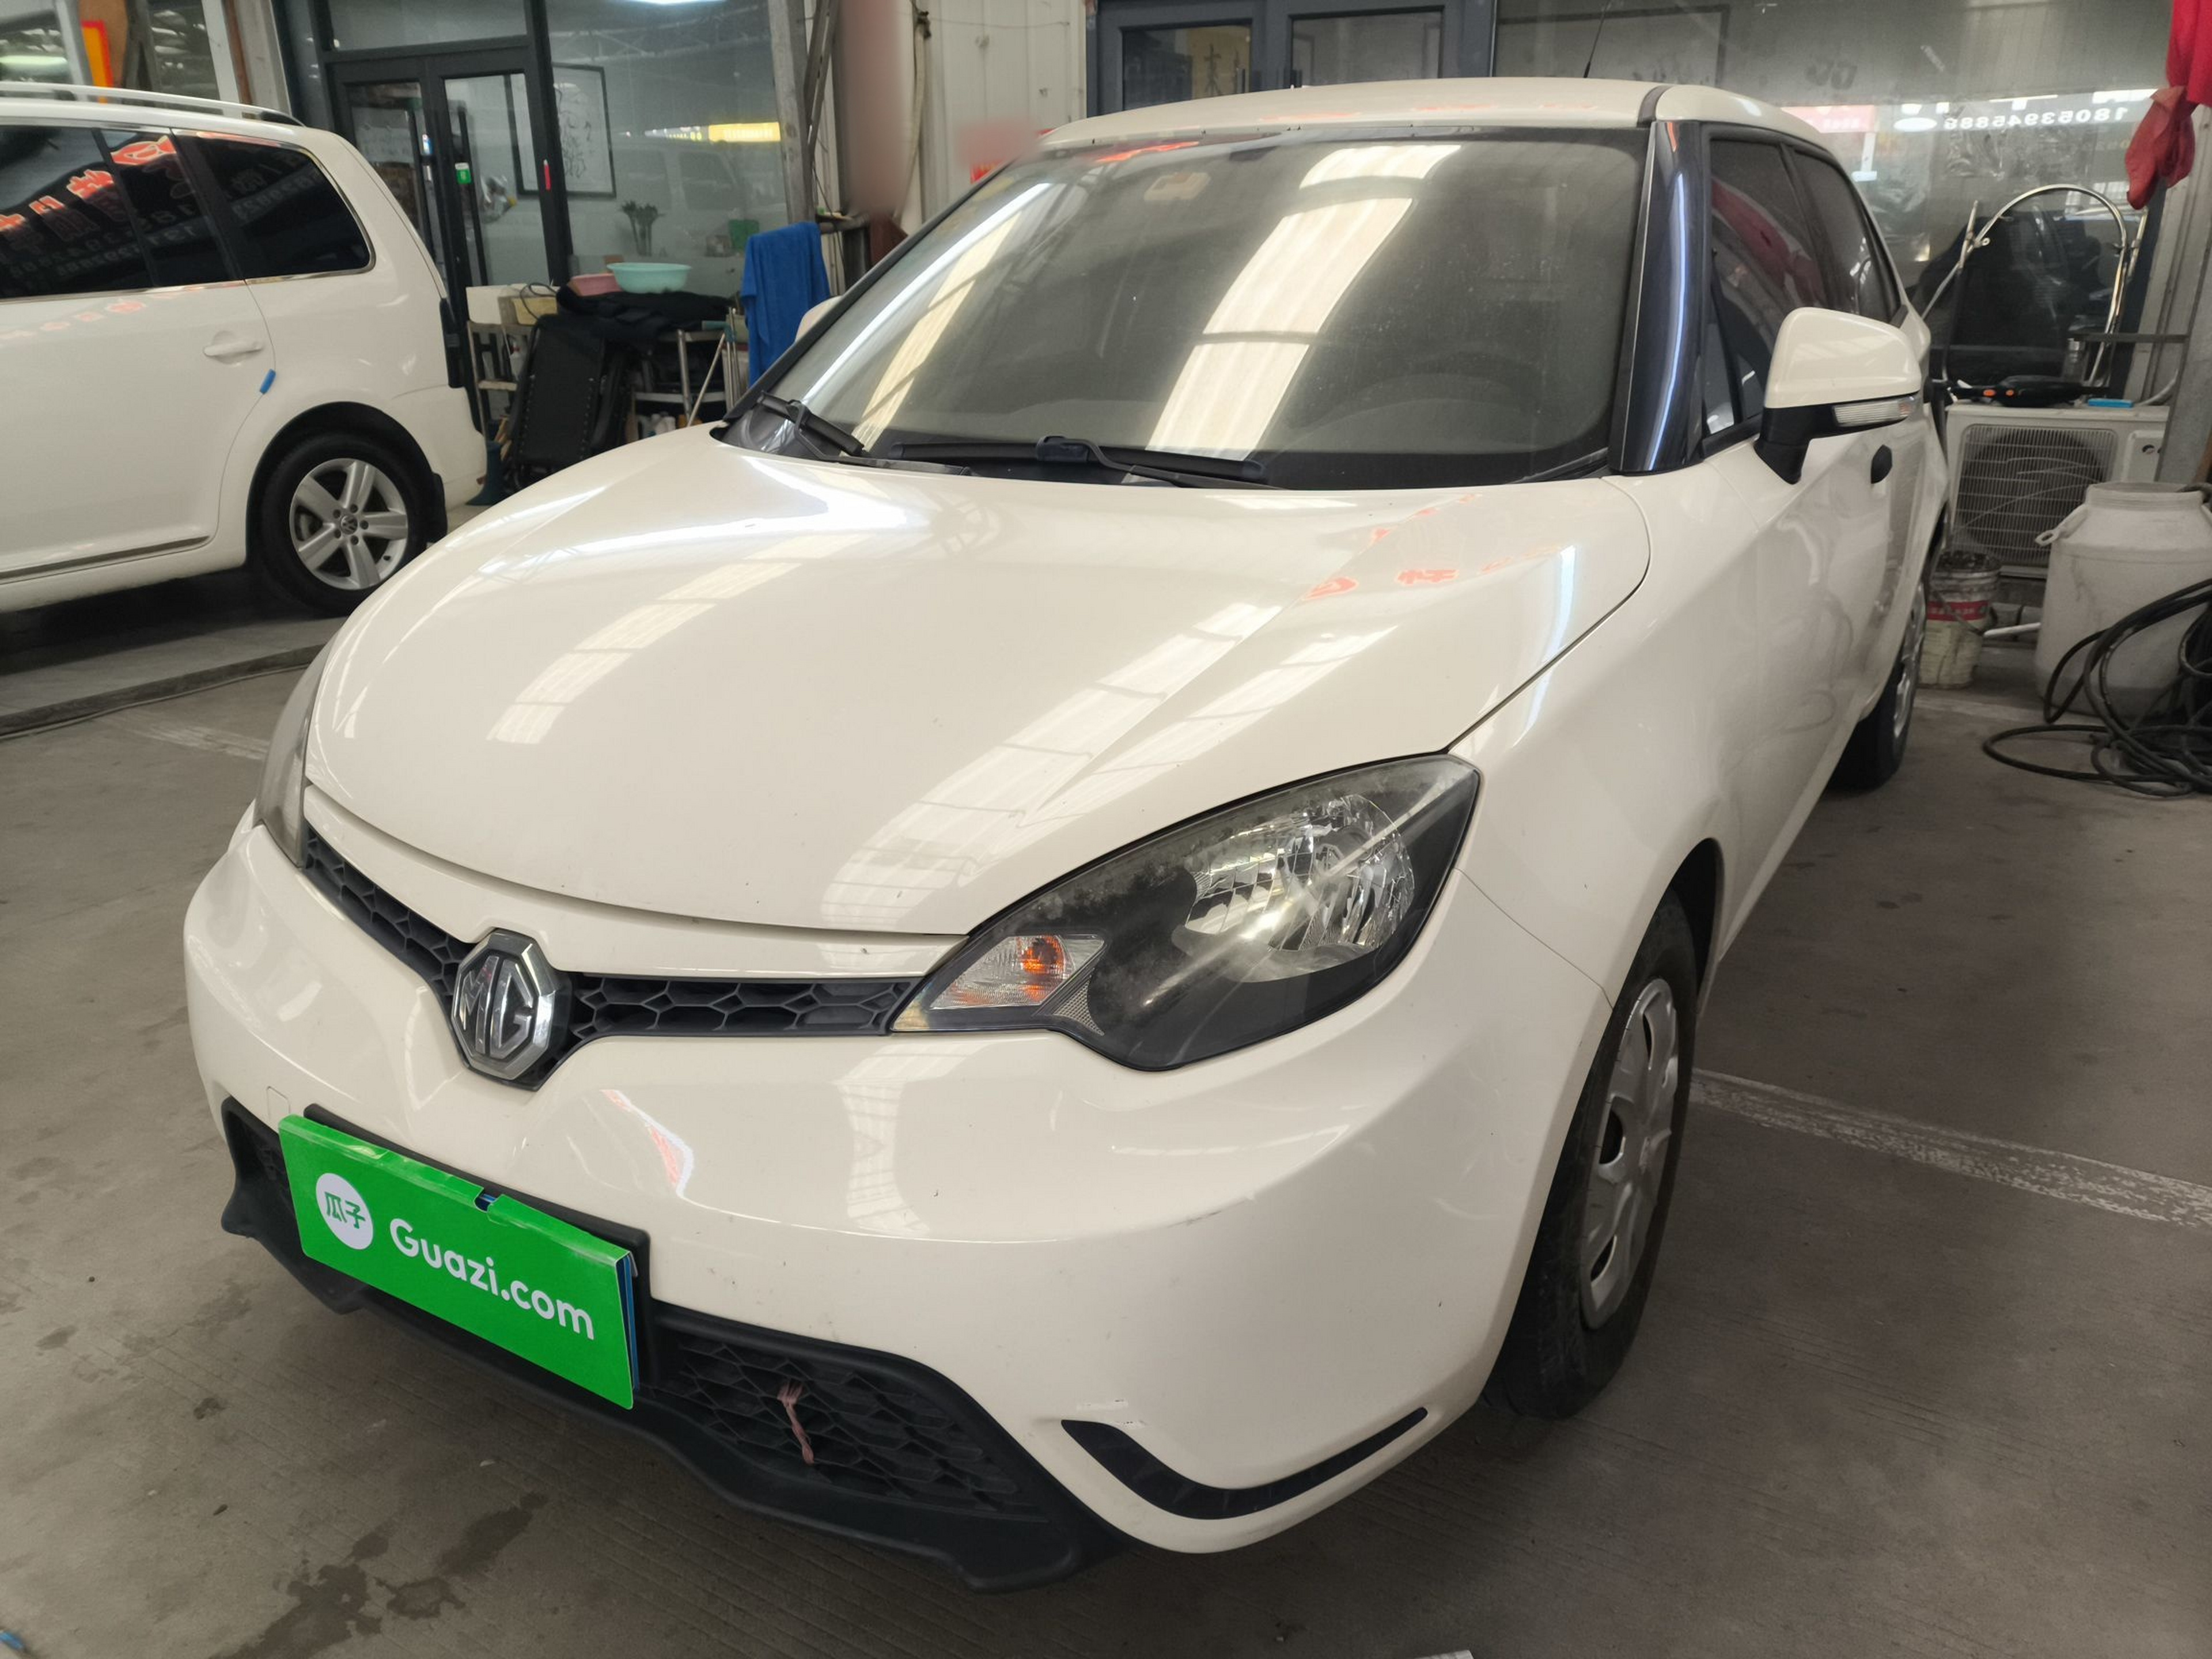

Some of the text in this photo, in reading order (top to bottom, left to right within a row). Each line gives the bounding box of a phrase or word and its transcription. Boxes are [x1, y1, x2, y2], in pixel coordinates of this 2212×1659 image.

[459, 955, 533, 1060] MG
[324, 1191, 366, 1229] 瓜子
[389, 1218, 594, 1340] Guazi.com
